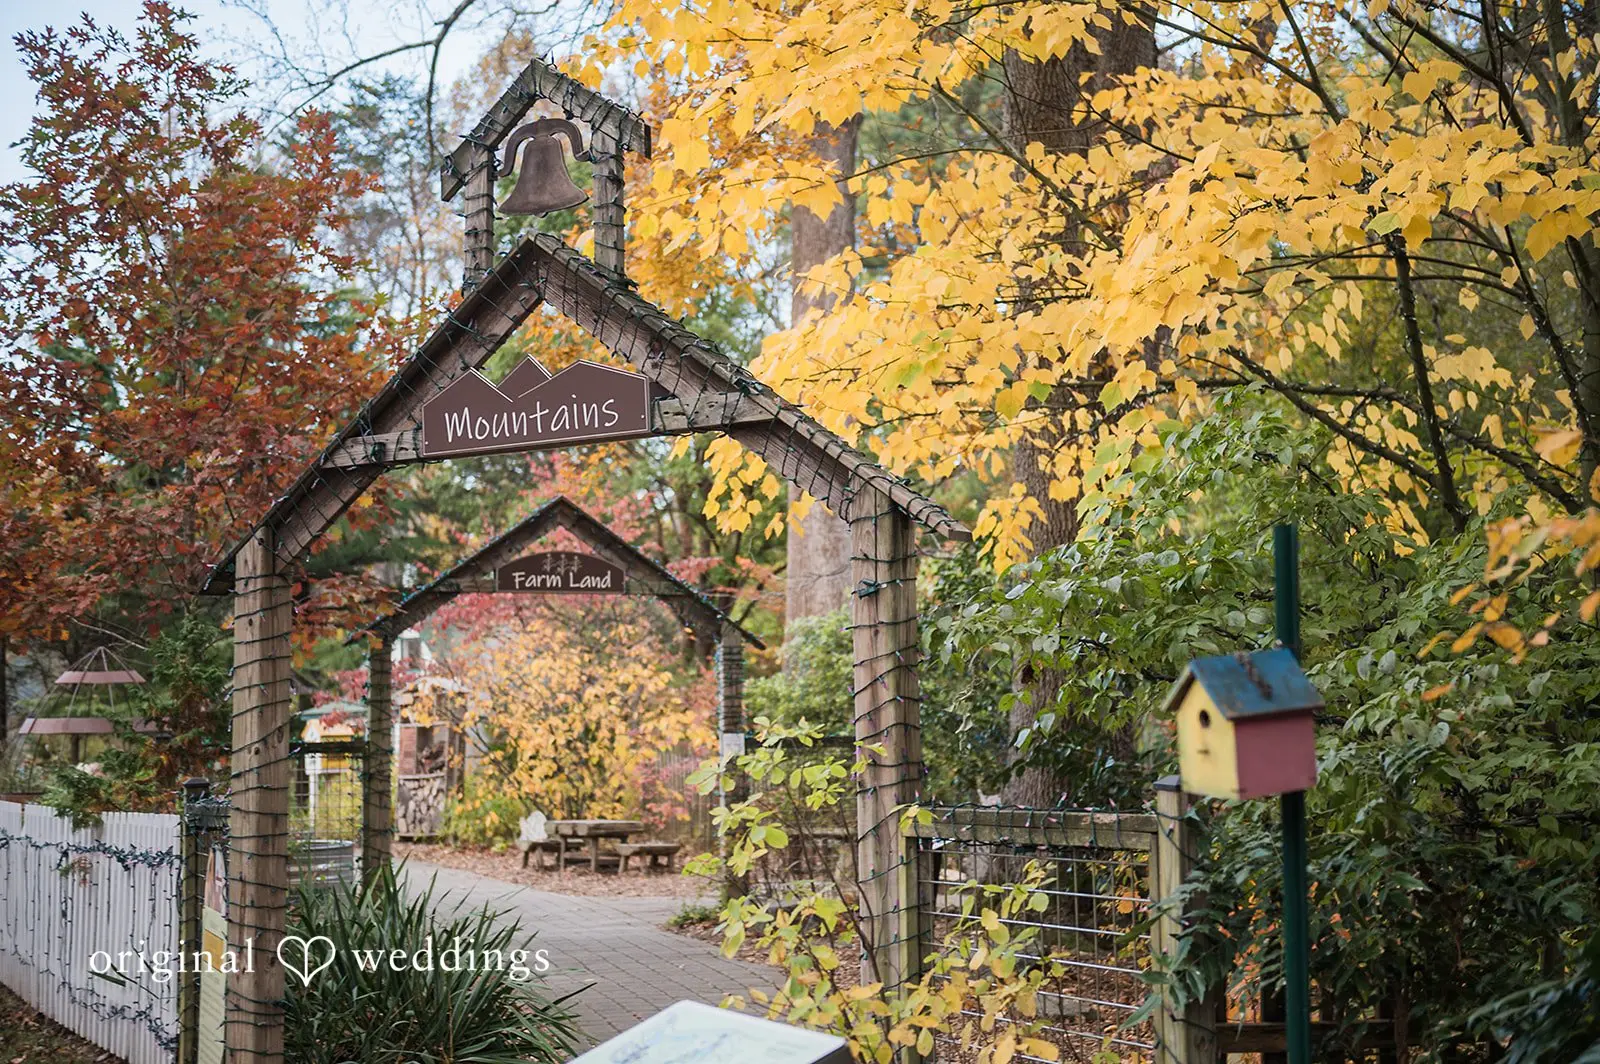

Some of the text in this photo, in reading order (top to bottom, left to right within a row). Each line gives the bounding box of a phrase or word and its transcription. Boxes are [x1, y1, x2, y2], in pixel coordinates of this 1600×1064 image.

[444, 394, 619, 442] Mountains
[512, 571, 611, 589] Farm Land
